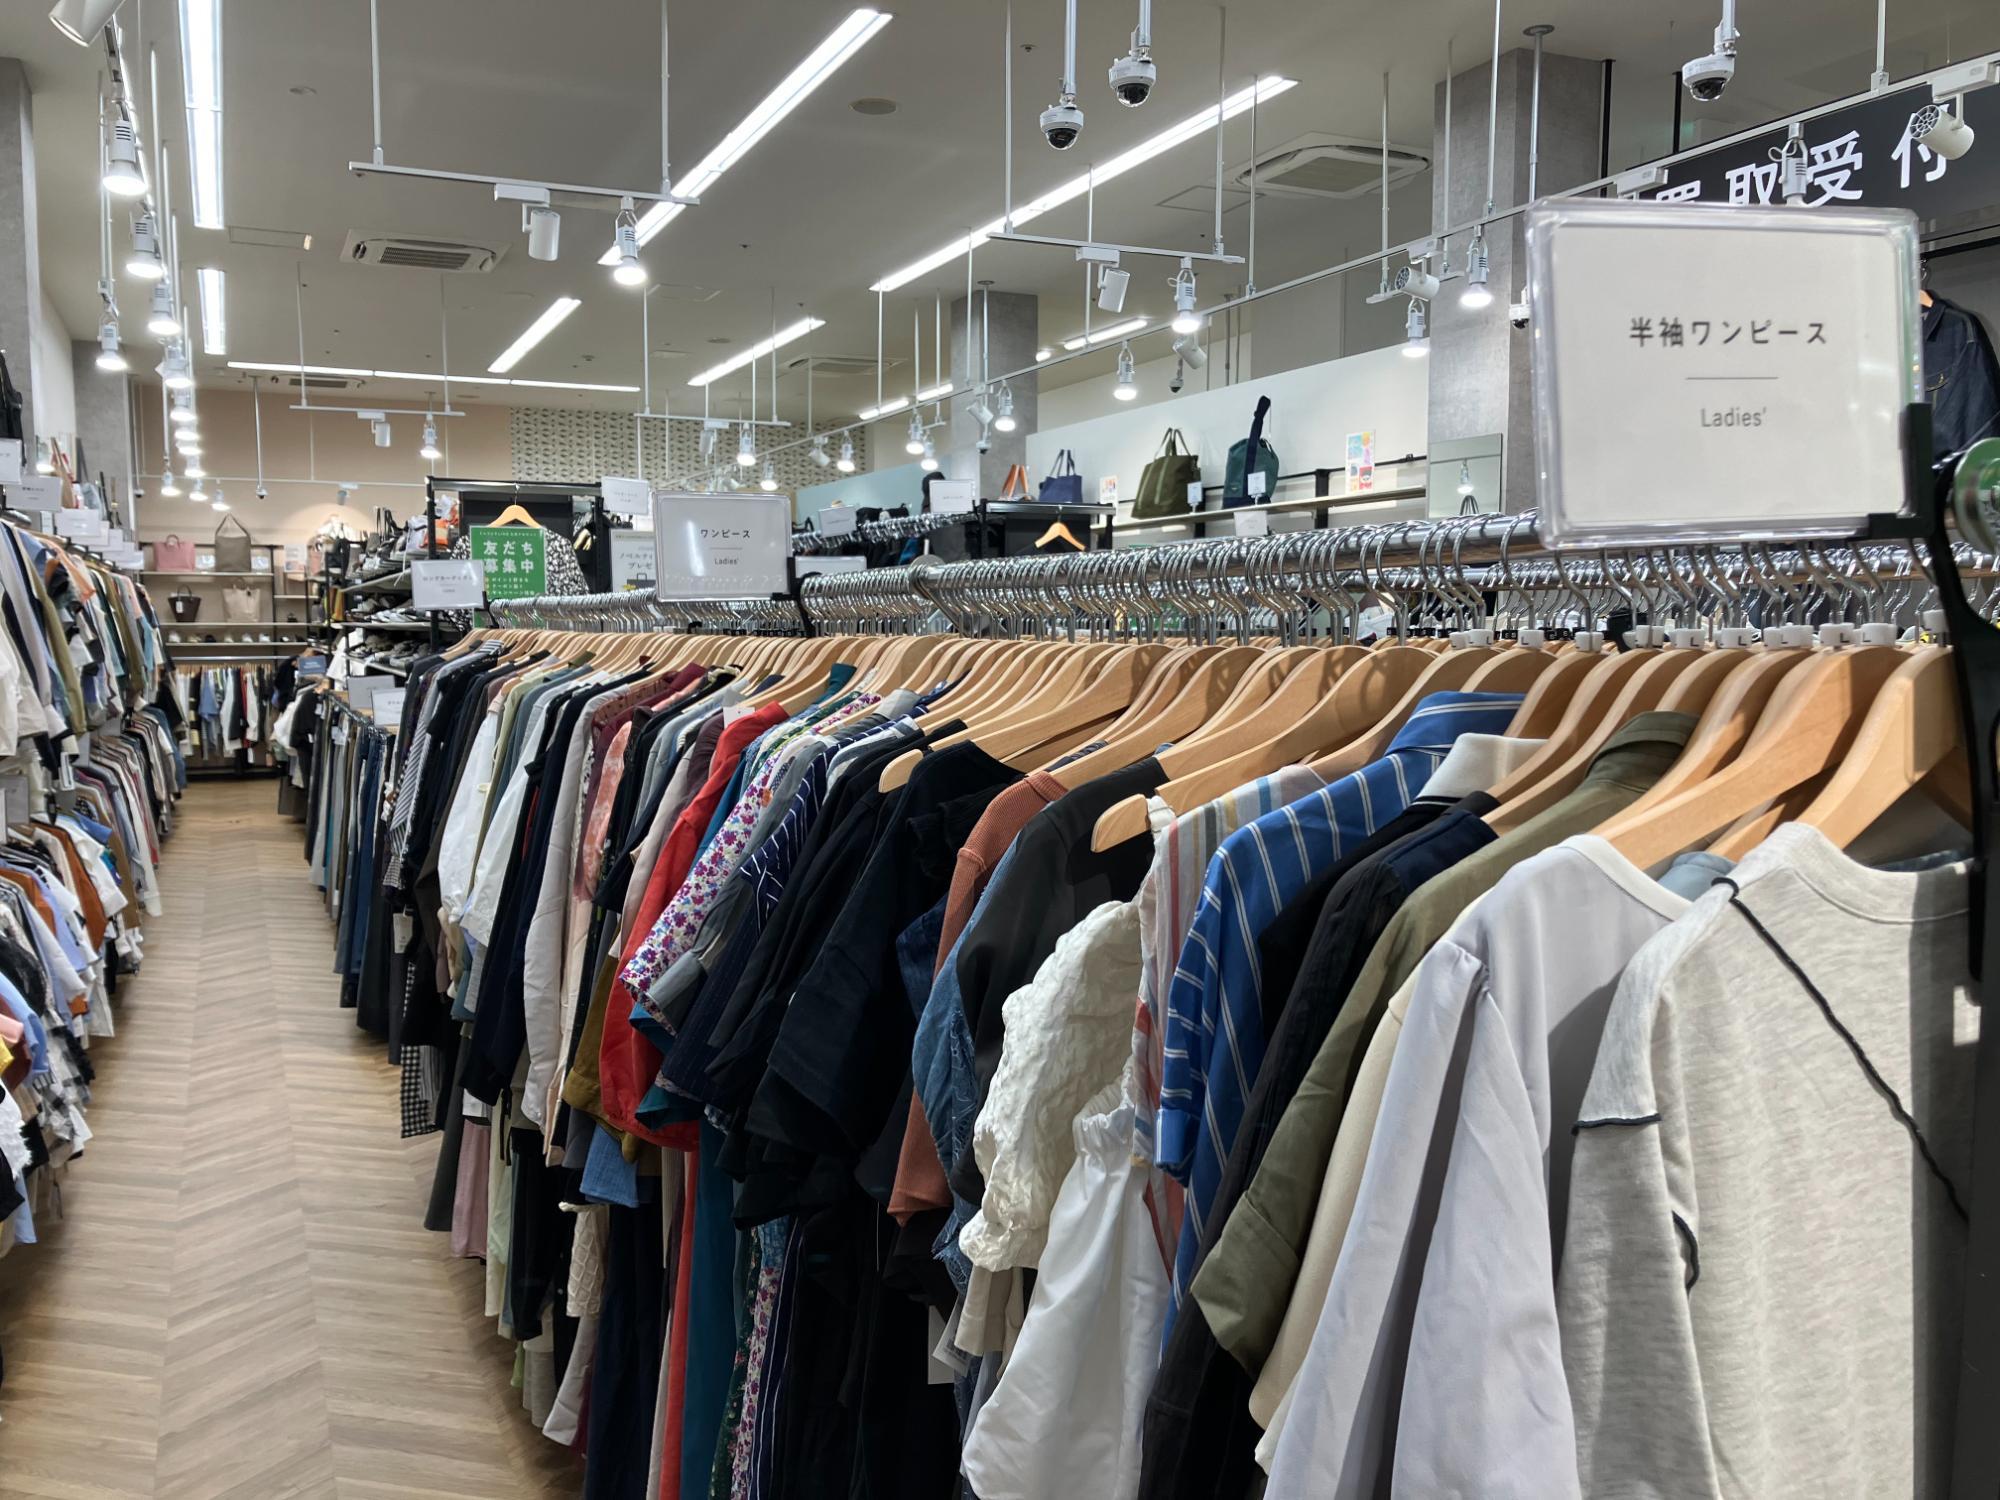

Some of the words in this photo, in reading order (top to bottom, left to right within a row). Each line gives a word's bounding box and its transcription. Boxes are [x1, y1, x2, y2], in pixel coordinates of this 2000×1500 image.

[1629, 316, 1828, 347] 半袖ワンピース
[1701, 408, 1768, 428] Ladies'
[700, 528, 751, 539] ワンピース
[483, 540, 533, 556] 友だち
[483, 558, 534, 574] 募集中
